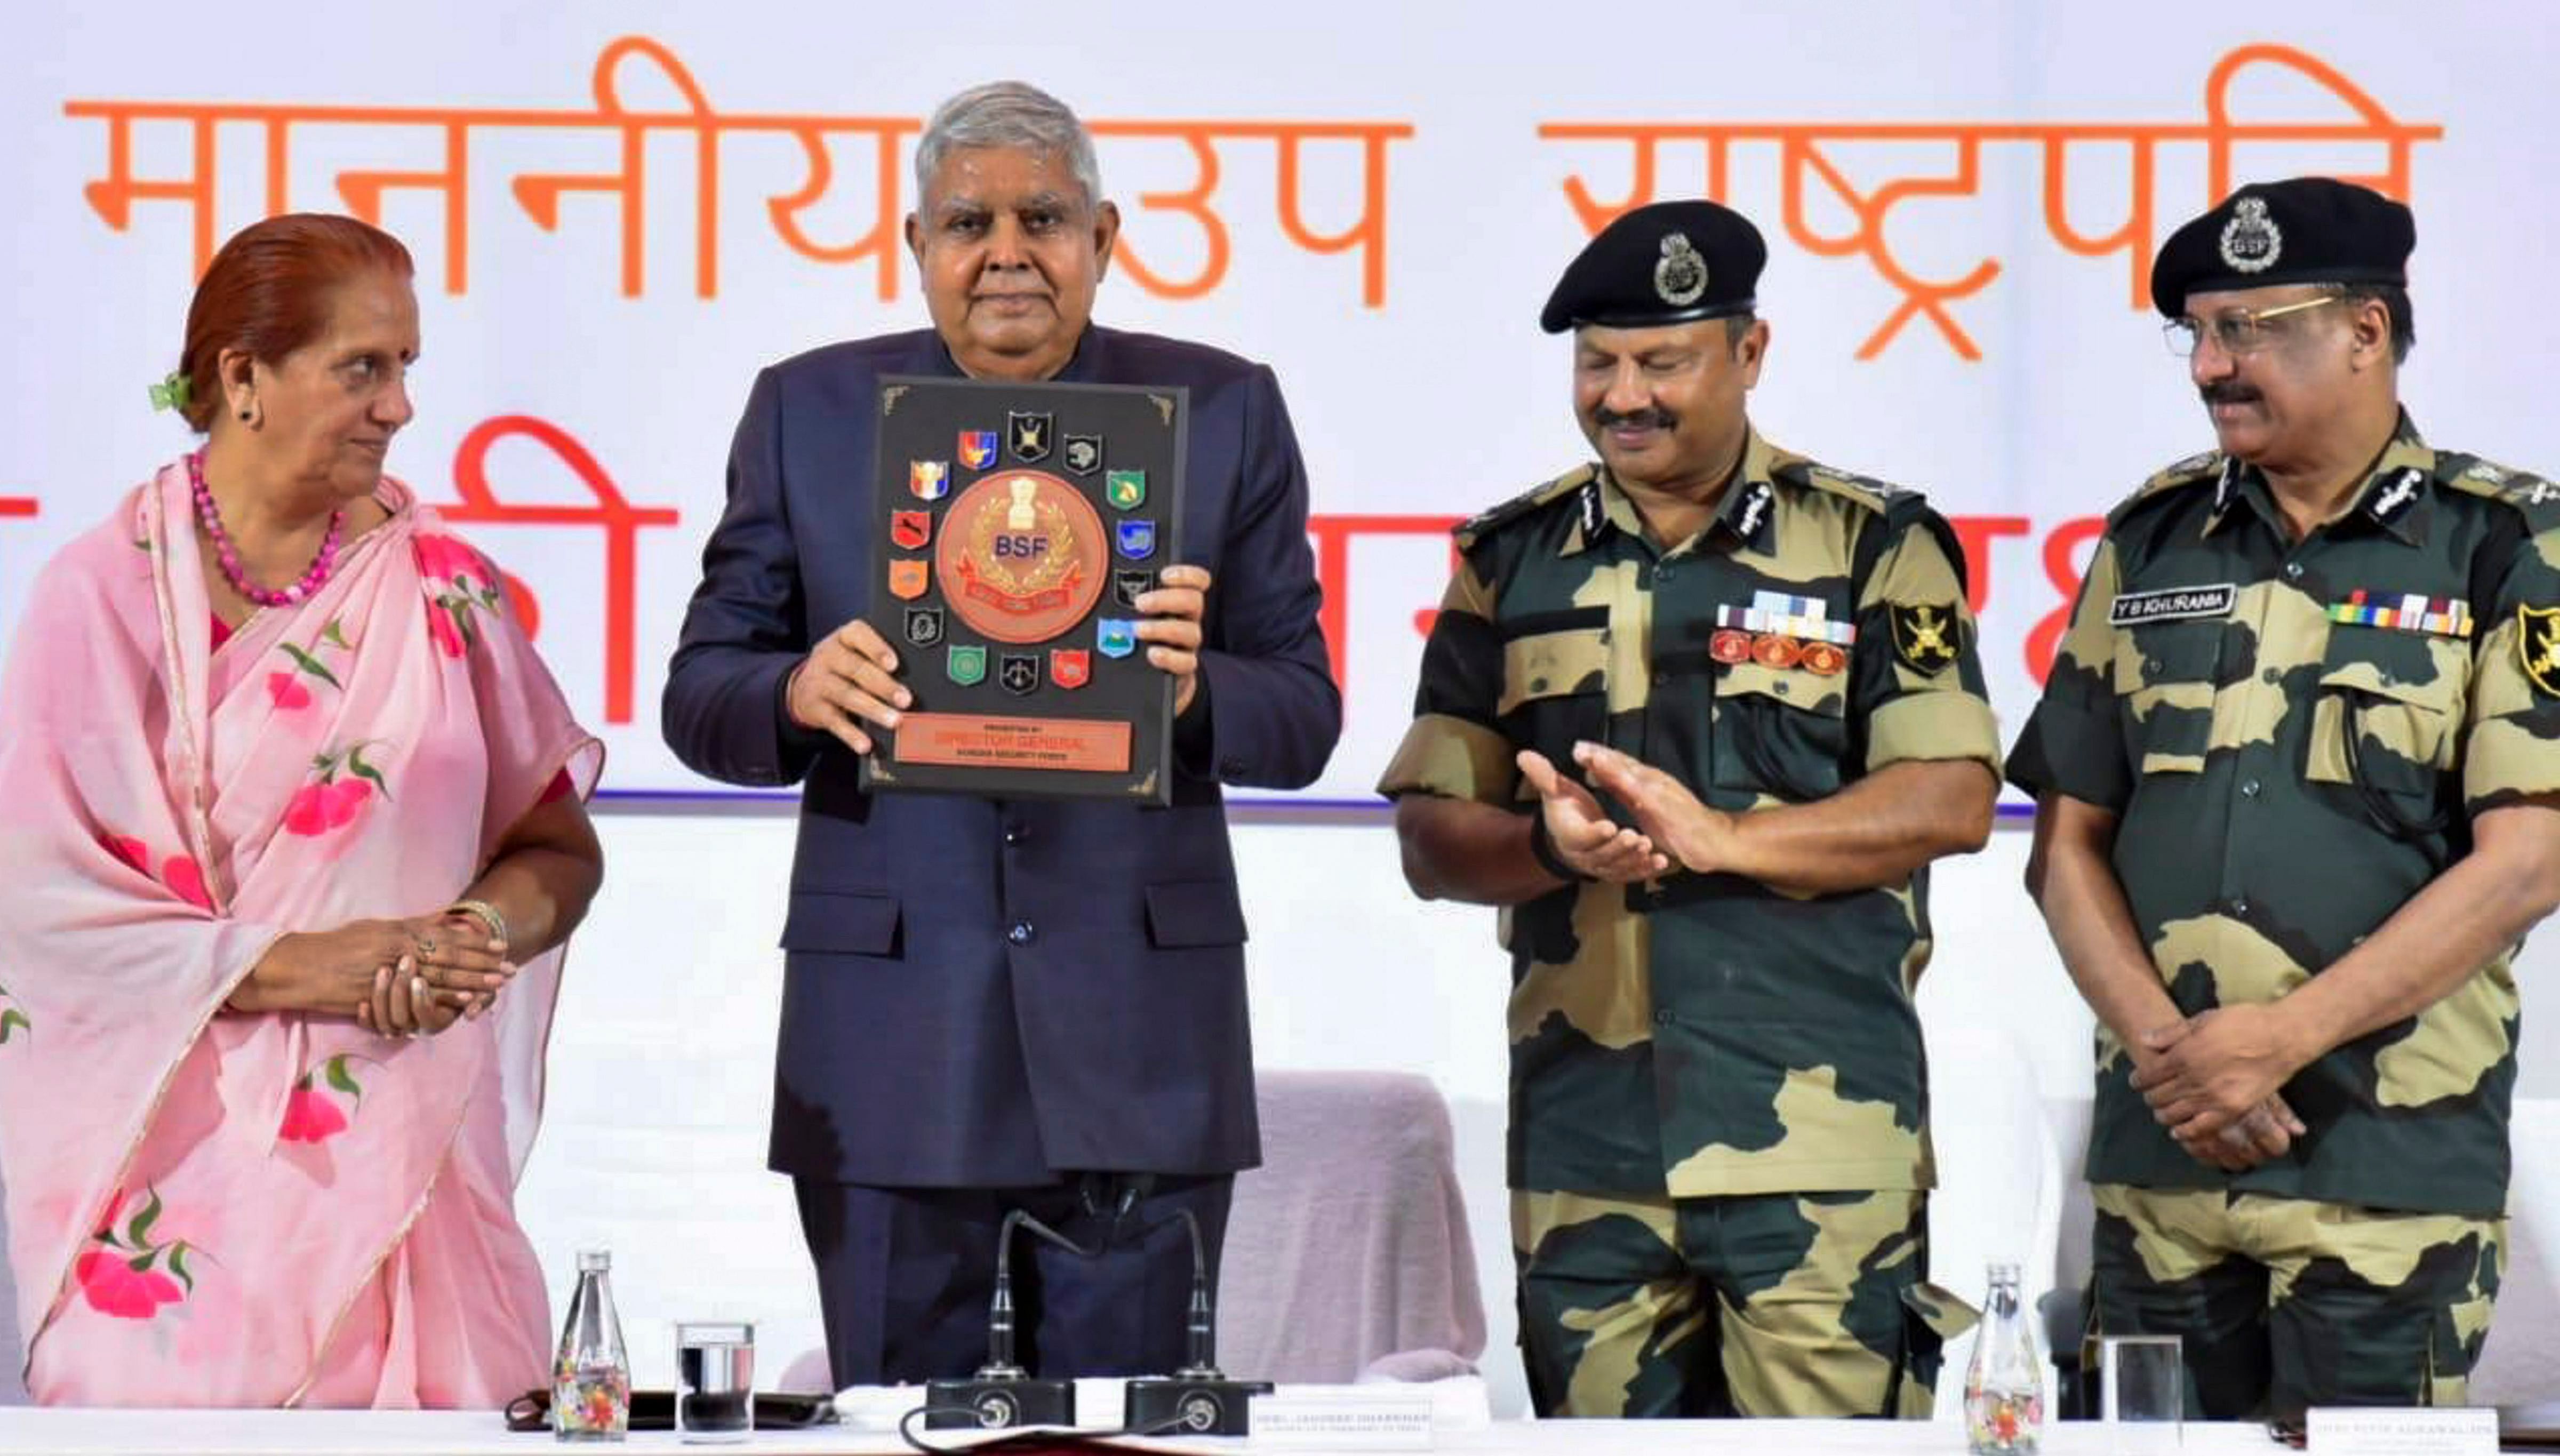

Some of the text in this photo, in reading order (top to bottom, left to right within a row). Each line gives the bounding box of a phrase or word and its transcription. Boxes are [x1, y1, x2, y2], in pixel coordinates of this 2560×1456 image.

[63, 35, 924, 302] माननीय
[1082, 121, 1414, 307] उप
[995, 535, 1048, 558] BSF
[2118, 603, 2129, 617] Y
